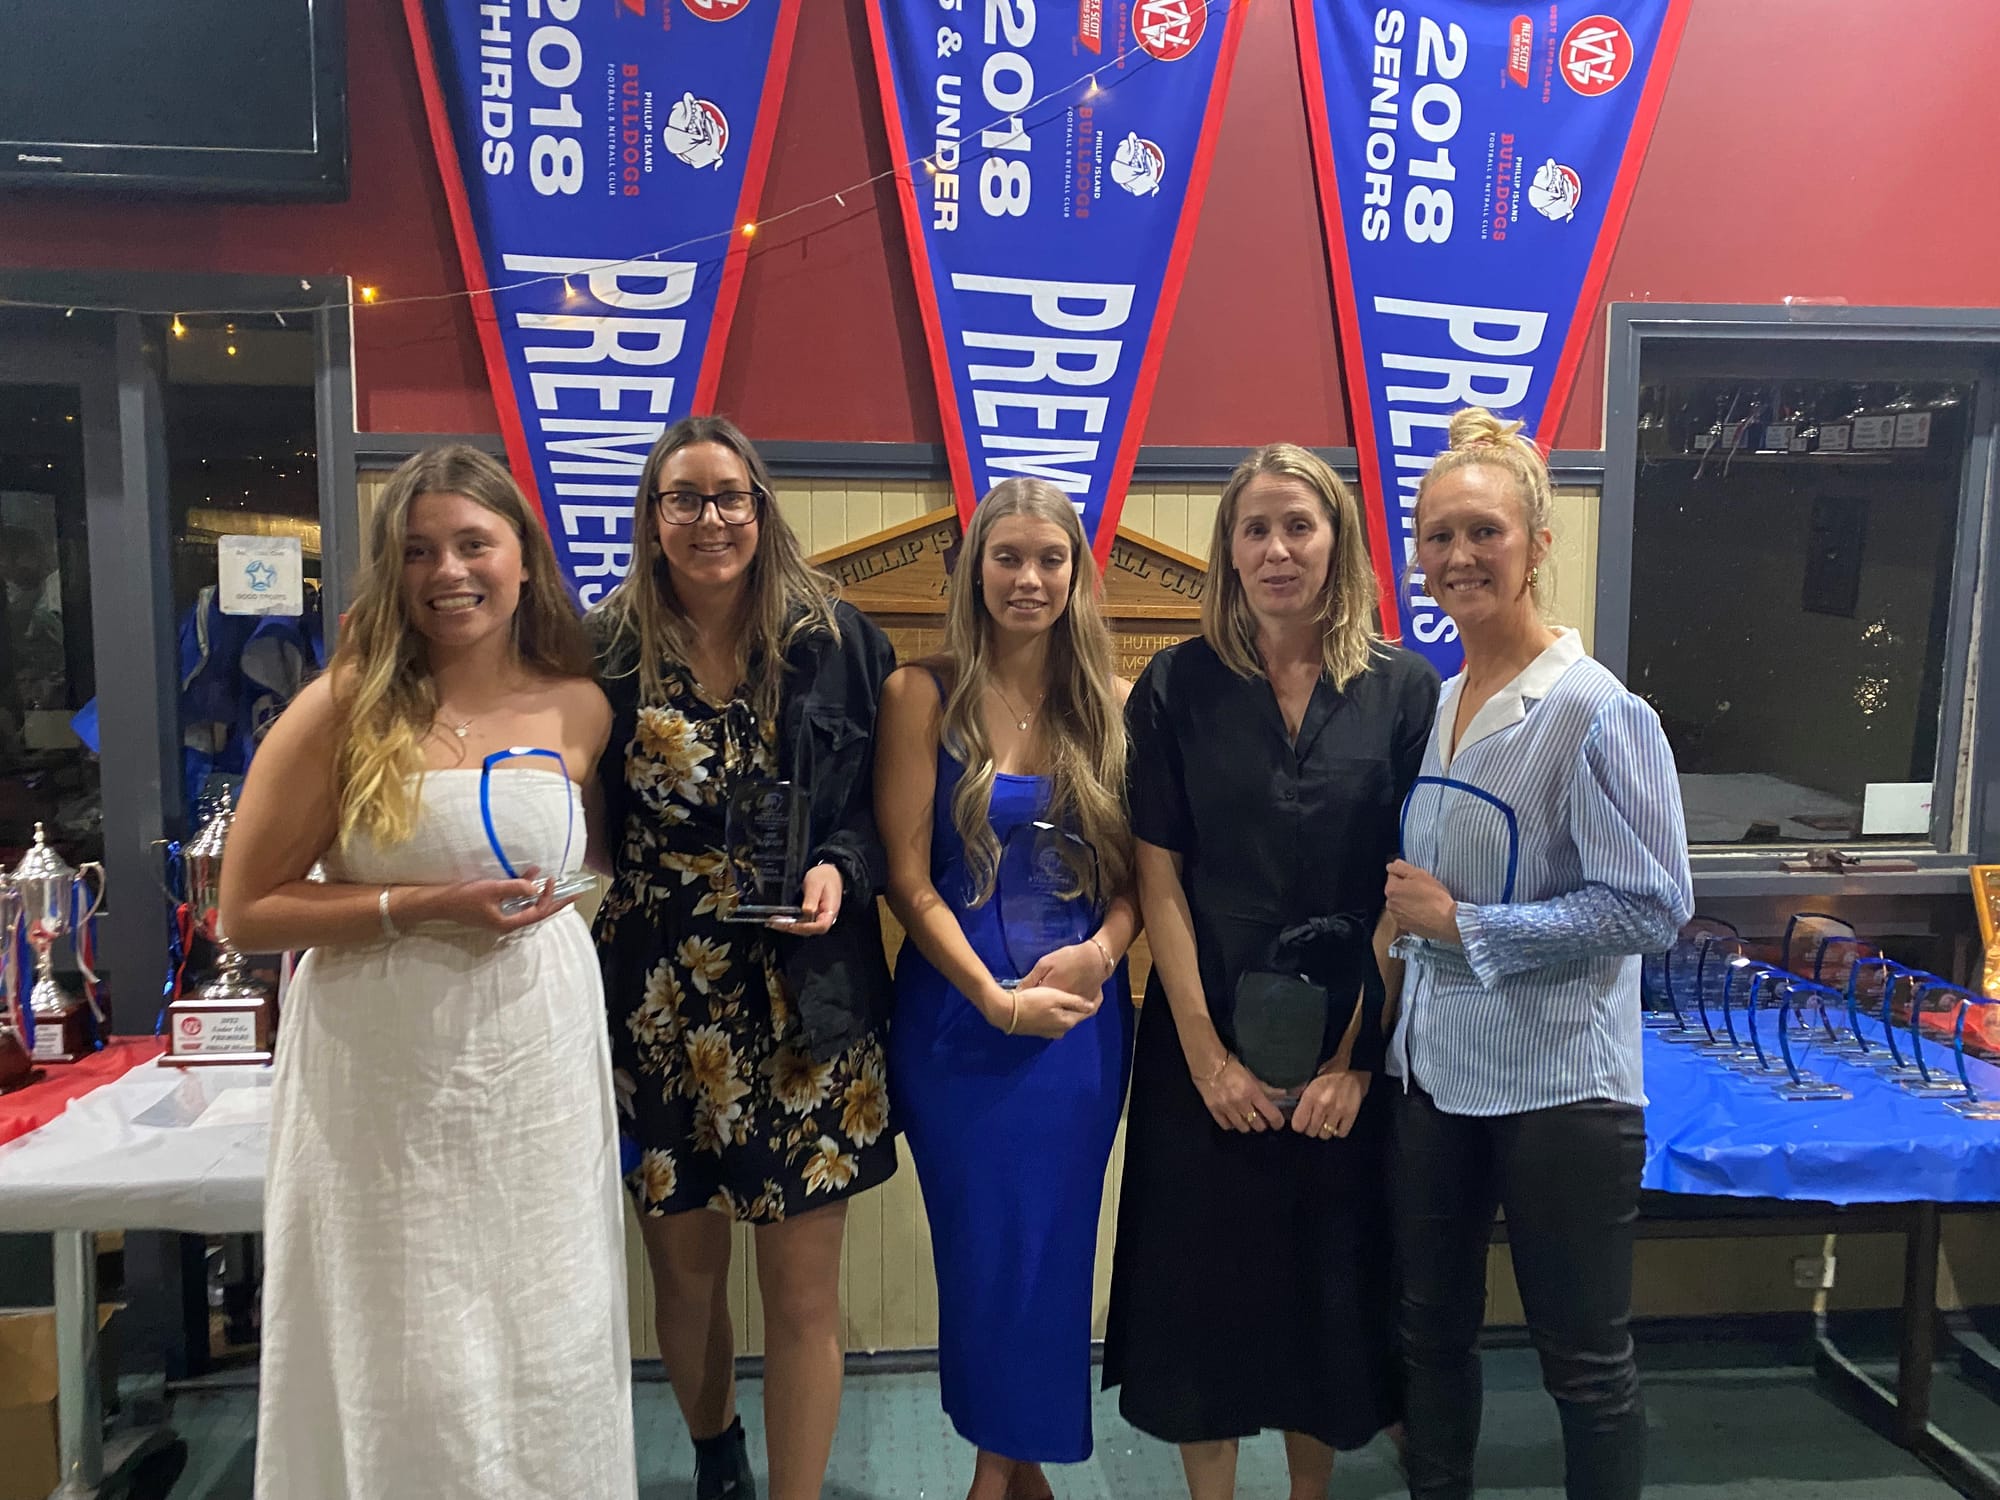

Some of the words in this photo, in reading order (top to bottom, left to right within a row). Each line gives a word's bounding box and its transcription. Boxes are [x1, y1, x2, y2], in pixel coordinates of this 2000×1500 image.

[1090, 10, 1100, 39] SCOTT
[1520, 22, 1531, 44] ALEX
[1550, 4, 1558, 33] WEST
[937, 26, 962, 58] &
[1511, 46, 1520, 69] STAFF
[1518, 44, 1530, 73] SCOTT
[480, 0, 514, 176] HIRDS
[607, 63, 616, 113] FOOTBALL
[1542, 38, 1556, 104] GIPPSLAND
[644, 91, 652, 131] PHILLIP
[979, 0, 1036, 217] 2018
[1066, 106, 1074, 147] FOOTBALL
[1361, 8, 1406, 242] SENIORS
[608, 125, 616, 168] NETBALL
[622, 63, 640, 197] BULLDOGS
[1095, 130, 1103, 162] PHILLIP
[1404, 16, 1468, 244] 2018
[644, 134, 653, 173] ISLAND
[934, 74, 961, 232] UNDER
[1075, 107, 1093, 219] BULLDOGS
[1487, 132, 1496, 171] FOOTBALL
[608, 171, 616, 196] CLUB
[1094, 165, 1102, 200] ISLAND
[1493, 133, 1514, 241] BULLDOGS
[1514, 156, 1523, 189] PHILLIP
[1483, 182, 1492, 217] NETBALL
[1511, 191, 1521, 223] ISLAND
[1481, 219, 1489, 240] CLUB
[502, 253, 698, 614] PREMIERS
[1159, 567, 1204, 600] CLU
